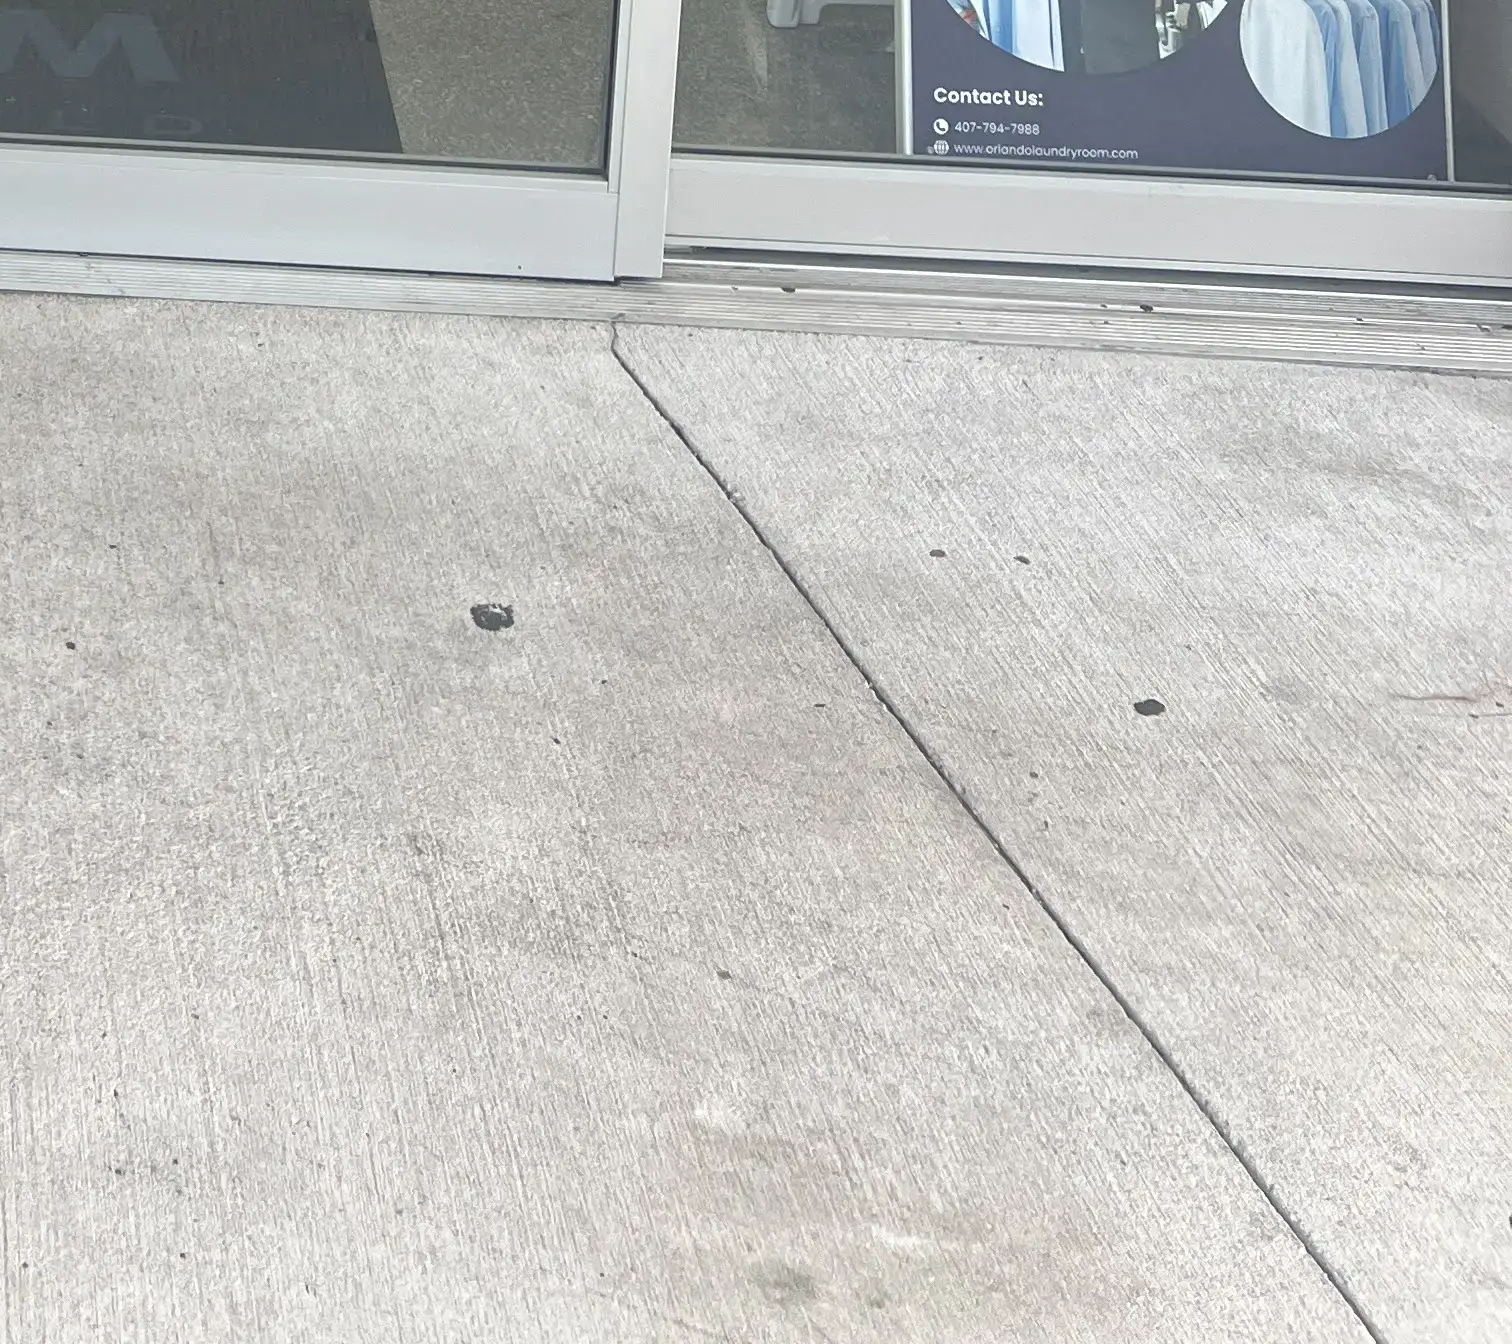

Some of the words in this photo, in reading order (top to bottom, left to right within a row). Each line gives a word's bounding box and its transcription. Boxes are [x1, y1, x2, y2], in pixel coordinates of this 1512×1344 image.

[933, 87, 1012, 105] Contact
[1014, 89, 1044, 106] Us:
[954, 121, 1041, 136] 407-794-7988
[953, 143, 1139, 160] www.orlandolaundryroom.com
